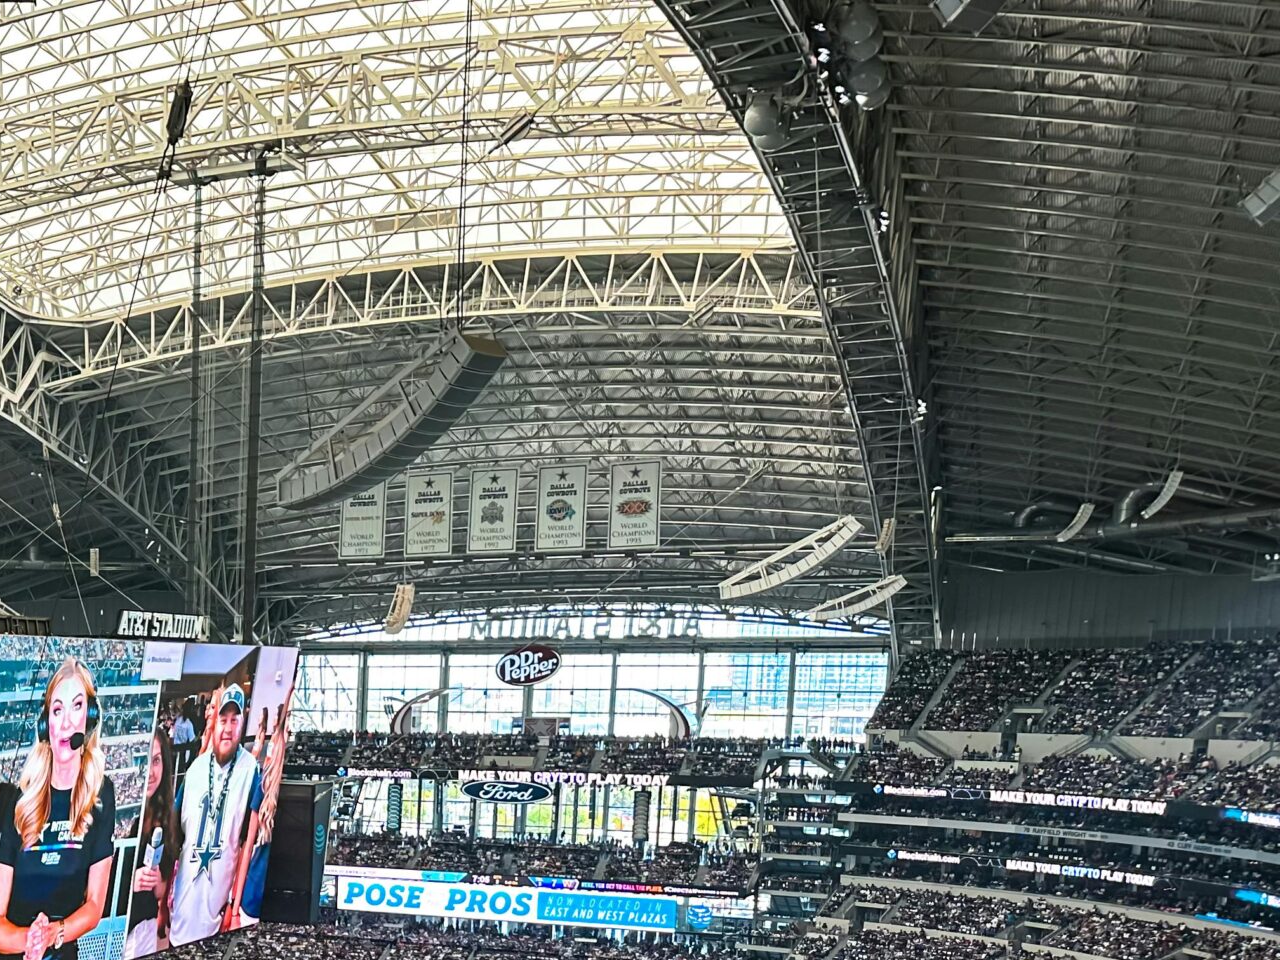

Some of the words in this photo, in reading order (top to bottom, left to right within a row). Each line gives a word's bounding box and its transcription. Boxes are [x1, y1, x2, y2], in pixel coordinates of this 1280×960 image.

[612, 529, 655, 538] CHAMPIONS
[620, 522, 648, 530] WORLD
[471, 533, 512, 541] CHAMPIONS
[539, 532, 581, 540] CHAMPIONS
[117, 610, 152, 637] AT&T
[152, 612, 204, 639] STADIUM
[520, 651, 543, 667] Dr
[504, 656, 558, 681] Pepper
[458, 770, 492, 781] MAKE
[495, 771, 531, 783] YOUR
[533, 772, 586, 785] CRYPTO
[588, 773, 623, 786] PLAY
[625, 775, 670, 787] TODAY
[479, 783, 533, 802] Ford
[884, 786, 947, 797] Blockchain.com
[990, 790, 1025, 802] MAKE
[1026, 792, 1056, 805] YOUR
[1057, 794, 1100, 809] CRYPTO
[1102, 798, 1130, 811] PLAY
[1131, 800, 1167, 815] TODAY
[898, 850, 960, 864] Blockchain.com
[1006, 858, 1035, 872] MAKE
[1036, 861, 1061, 875] YOUR
[1062, 865, 1100, 879] CRYPTO
[1101, 869, 1124, 882] PLAY
[1125, 872, 1155, 886] TODAY
[344, 882, 424, 908] POSE
[445, 888, 533, 917] PROS
[547, 896, 571, 906] NOW
[581, 897, 640, 909] LOCATED
[649, 901, 663, 912] IN
[544, 906, 569, 918] EAST
[573, 908, 592, 919] AND
[597, 910, 624, 921] WEST
[628, 911, 667, 924] PLAZAS
